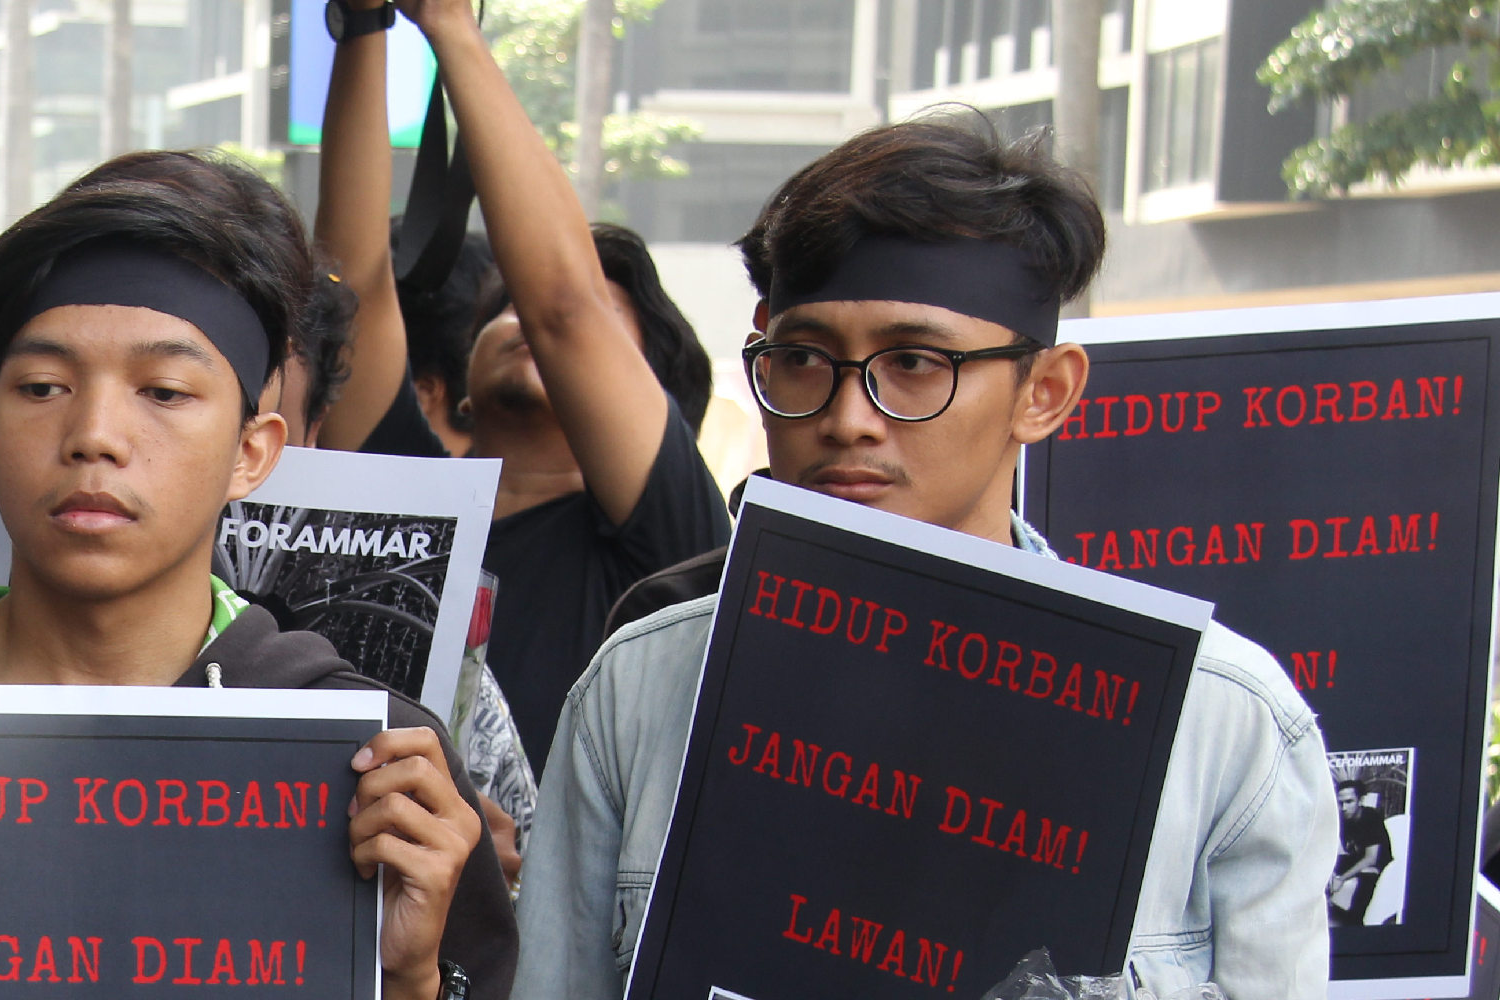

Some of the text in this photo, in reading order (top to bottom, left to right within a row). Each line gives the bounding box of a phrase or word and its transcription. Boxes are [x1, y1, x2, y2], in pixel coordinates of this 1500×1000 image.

[1057, 374, 1464, 441] HIDUP KORBAN!
[219, 517, 433, 559] FORAMMAR
[1066, 511, 1440, 571] JANGAN DIAM!
[747, 570, 1140, 727] HIDUP KORBAN!
[72, 776, 331, 829] KORBAN!
[727, 723, 1090, 875] JANGAN DIAM!
[130, 936, 308, 987] DIAM!
[781, 893, 965, 994] LAWAN!
